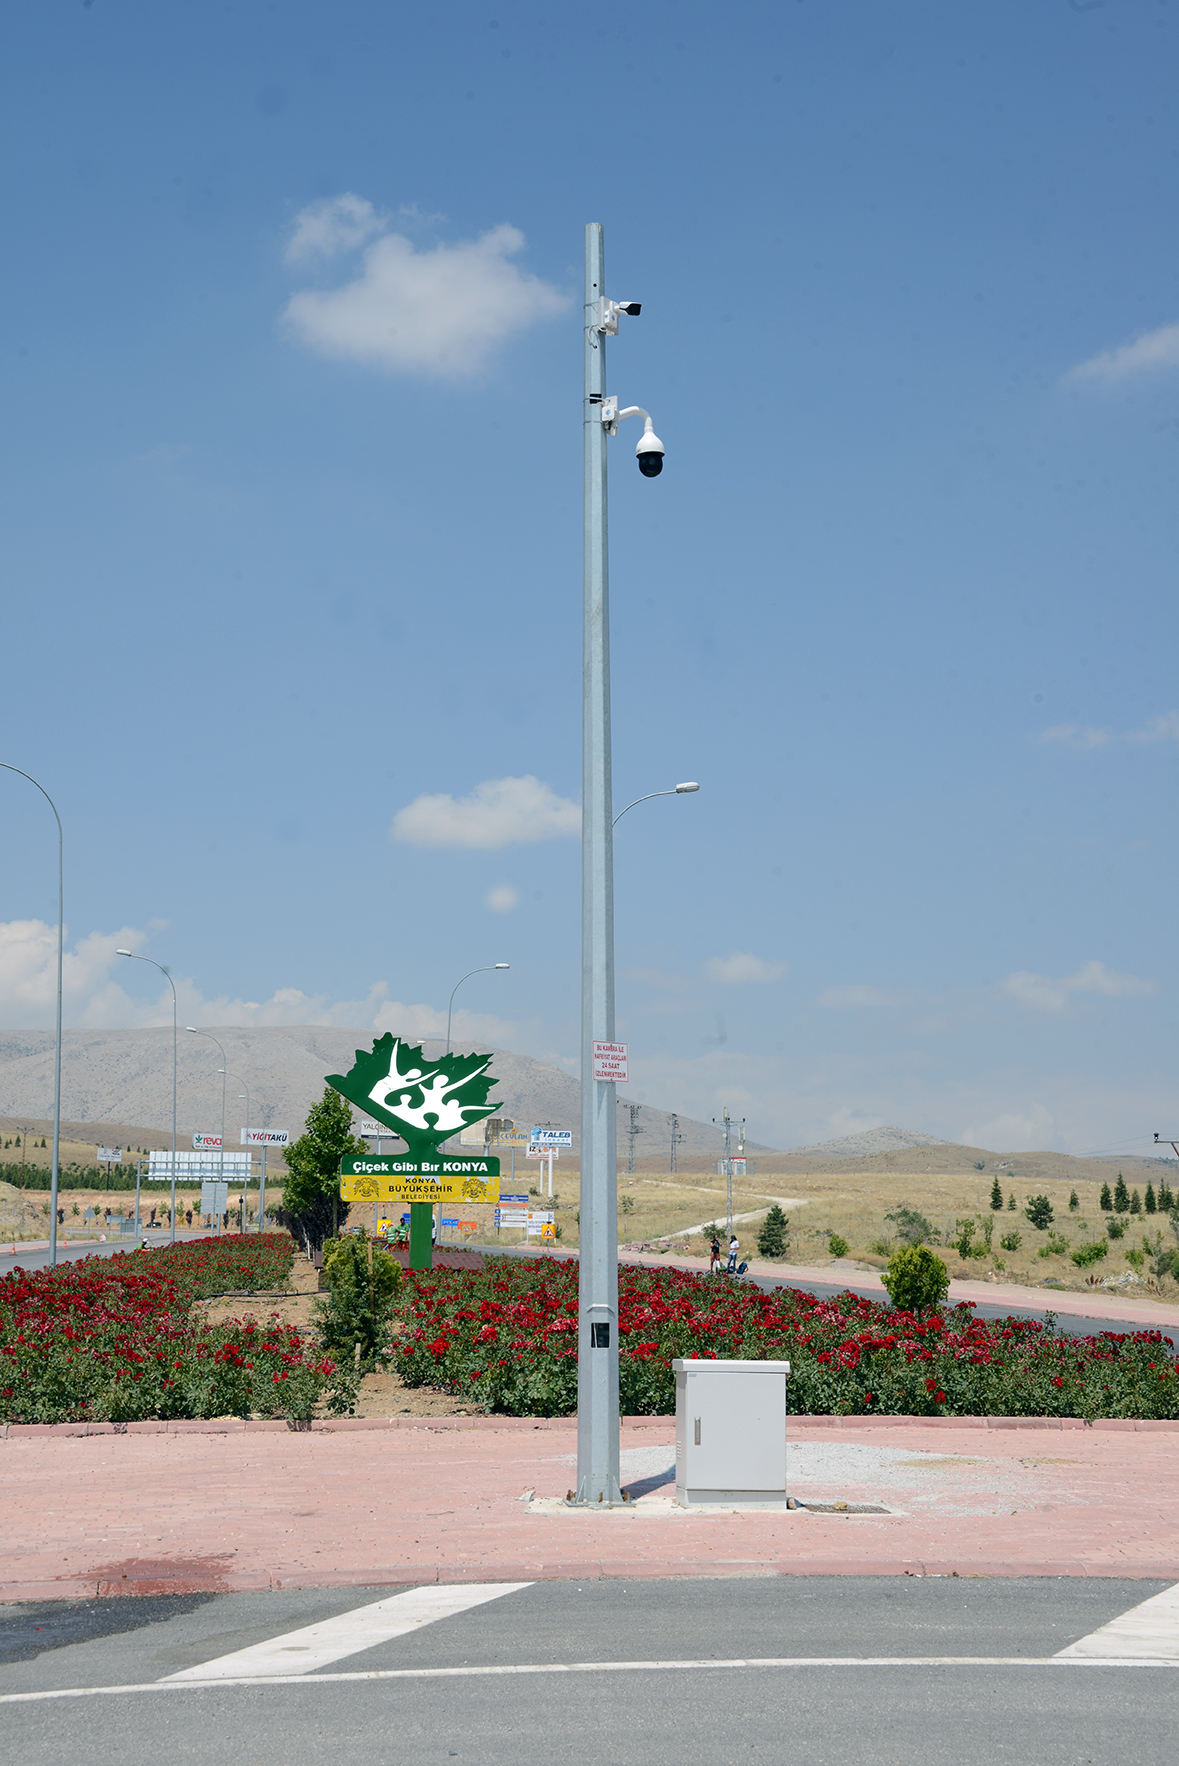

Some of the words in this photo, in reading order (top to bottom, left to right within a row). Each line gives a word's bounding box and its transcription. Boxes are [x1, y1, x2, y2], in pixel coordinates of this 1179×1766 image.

[203, 1137, 222, 1146] reva
[353, 1161, 389, 1174] Çiçek
[443, 1162, 488, 1172] KONYA
[388, 1184, 453, 1194] BÜYÜKŞEHİR
